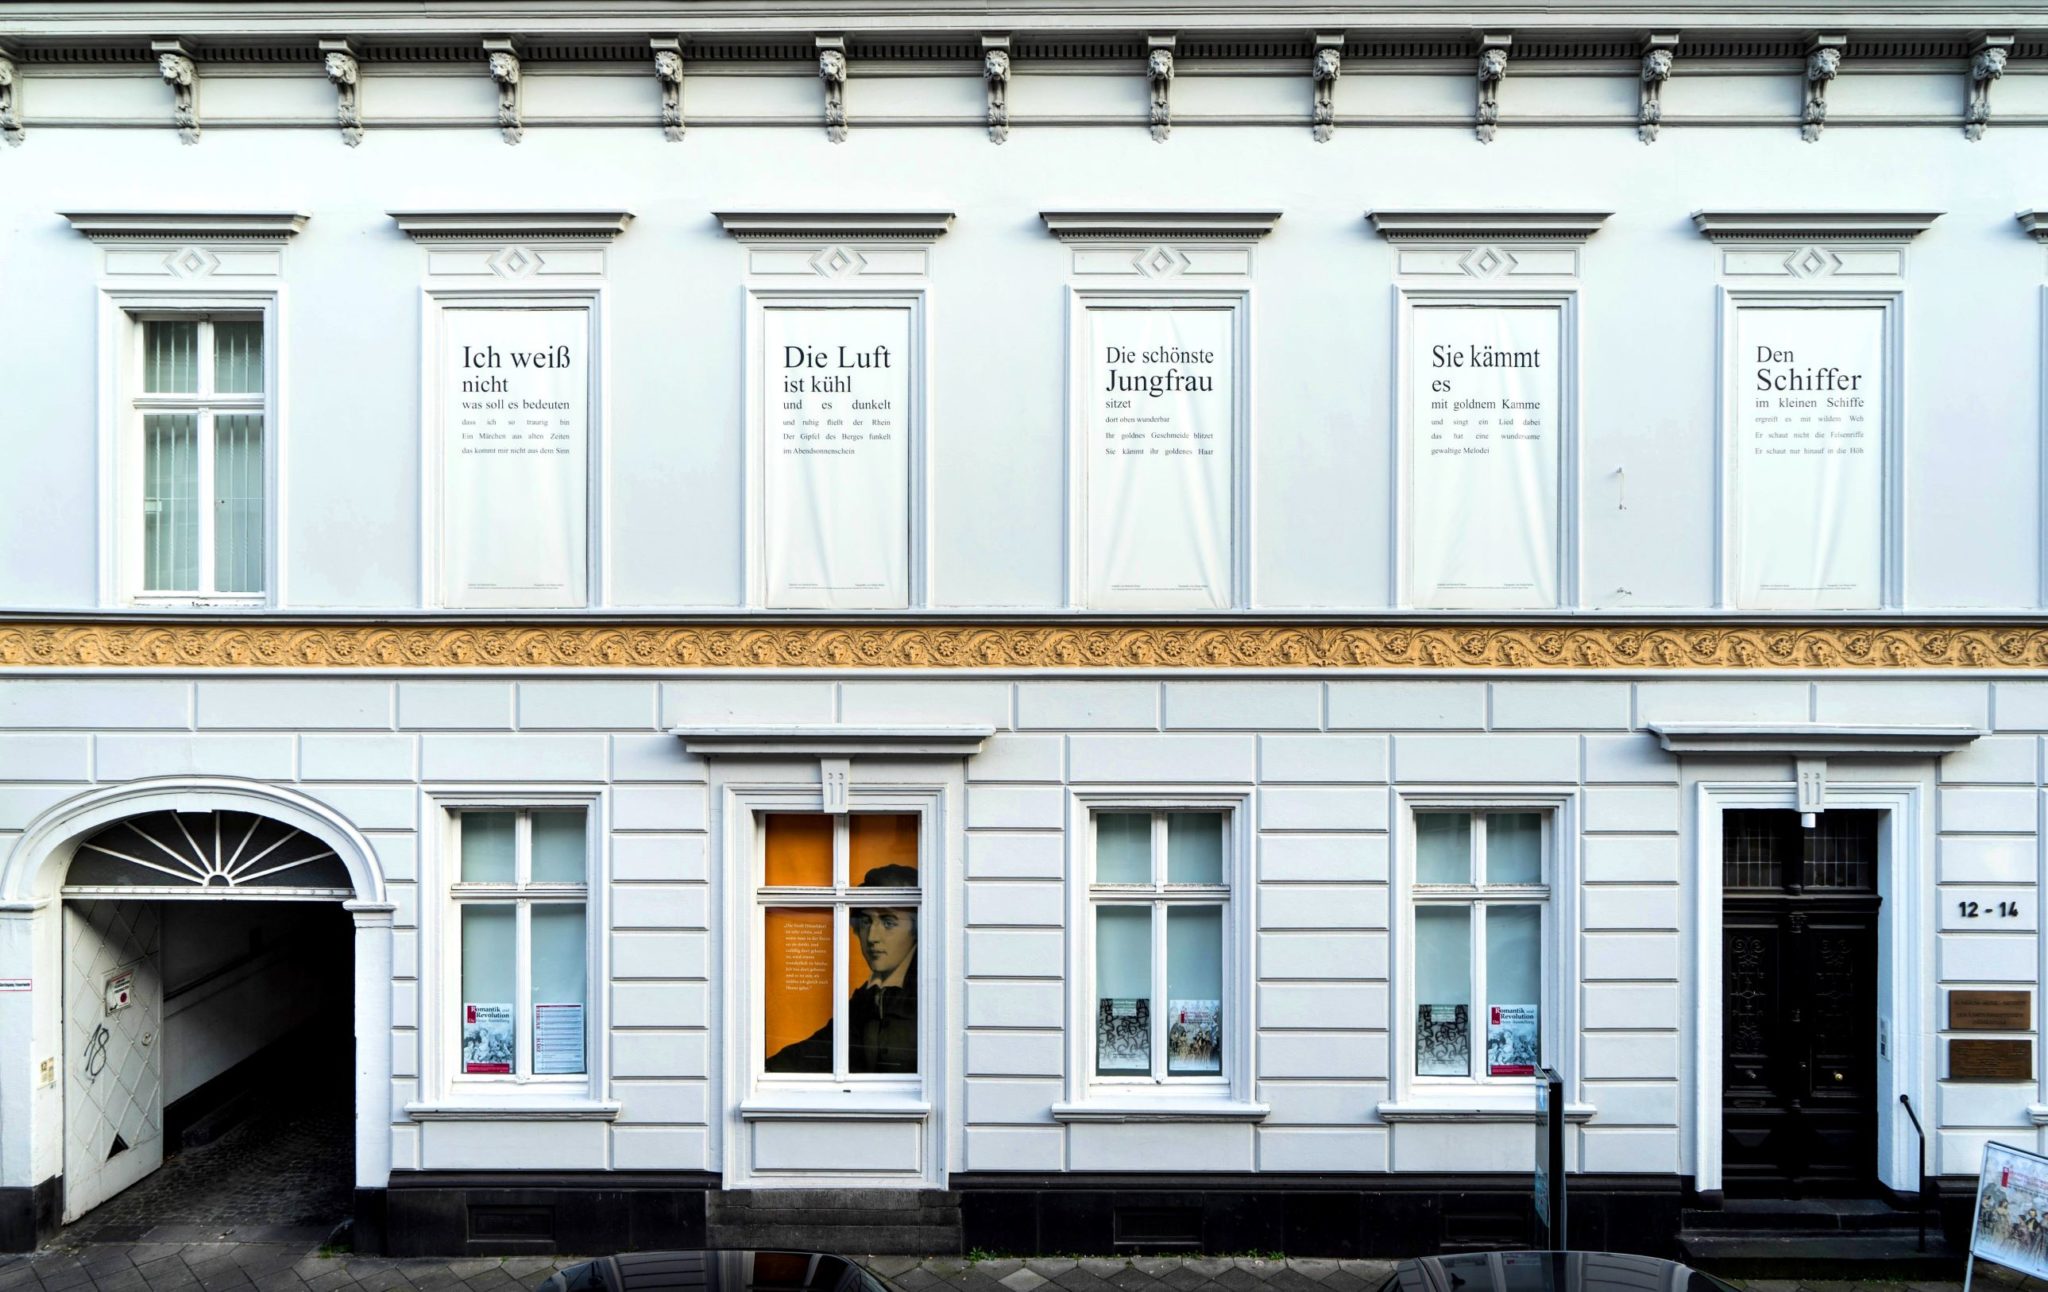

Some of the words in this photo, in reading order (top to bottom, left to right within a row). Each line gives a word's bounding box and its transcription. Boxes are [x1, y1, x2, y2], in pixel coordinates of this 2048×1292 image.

[463, 345, 501, 368] Ich
[510, 345, 570, 368] weiß
[784, 345, 828, 368] Die
[838, 345, 891, 368] Luft
[1106, 346, 1135, 363] Die
[1142, 346, 1214, 364] schönste
[1433, 345, 1464, 368] Sie
[1471, 344, 1540, 368] kämmt
[1756, 346, 1794, 363] Den
[462, 375, 508, 392] nicht
[784, 375, 804, 393] ist
[811, 375, 851, 393] kühl
[1106, 368, 1213, 397] Jungfrau
[1432, 379, 1451, 392] es
[1757, 367, 1862, 391] Schiffer
[486, 400, 504, 409] soll
[523, 400, 570, 409] bedeuten
[784, 400, 802, 409] und
[852, 400, 891, 409] dunkelt
[1106, 399, 1131, 408] sitzet
[1432, 399, 1448, 409] mit
[1453, 399, 1496, 411] goldnem
[1502, 399, 1540, 409] Kamme
[1756, 398, 1769, 408] im
[1779, 398, 1817, 408] kleinen
[1827, 397, 1864, 408] Schiffe
[800, 433, 820, 441] Gipfel
[1431, 447, 1461, 455] gewaltige
[1959, 902, 1979, 918] 12
[1999, 902, 2018, 918] 14
